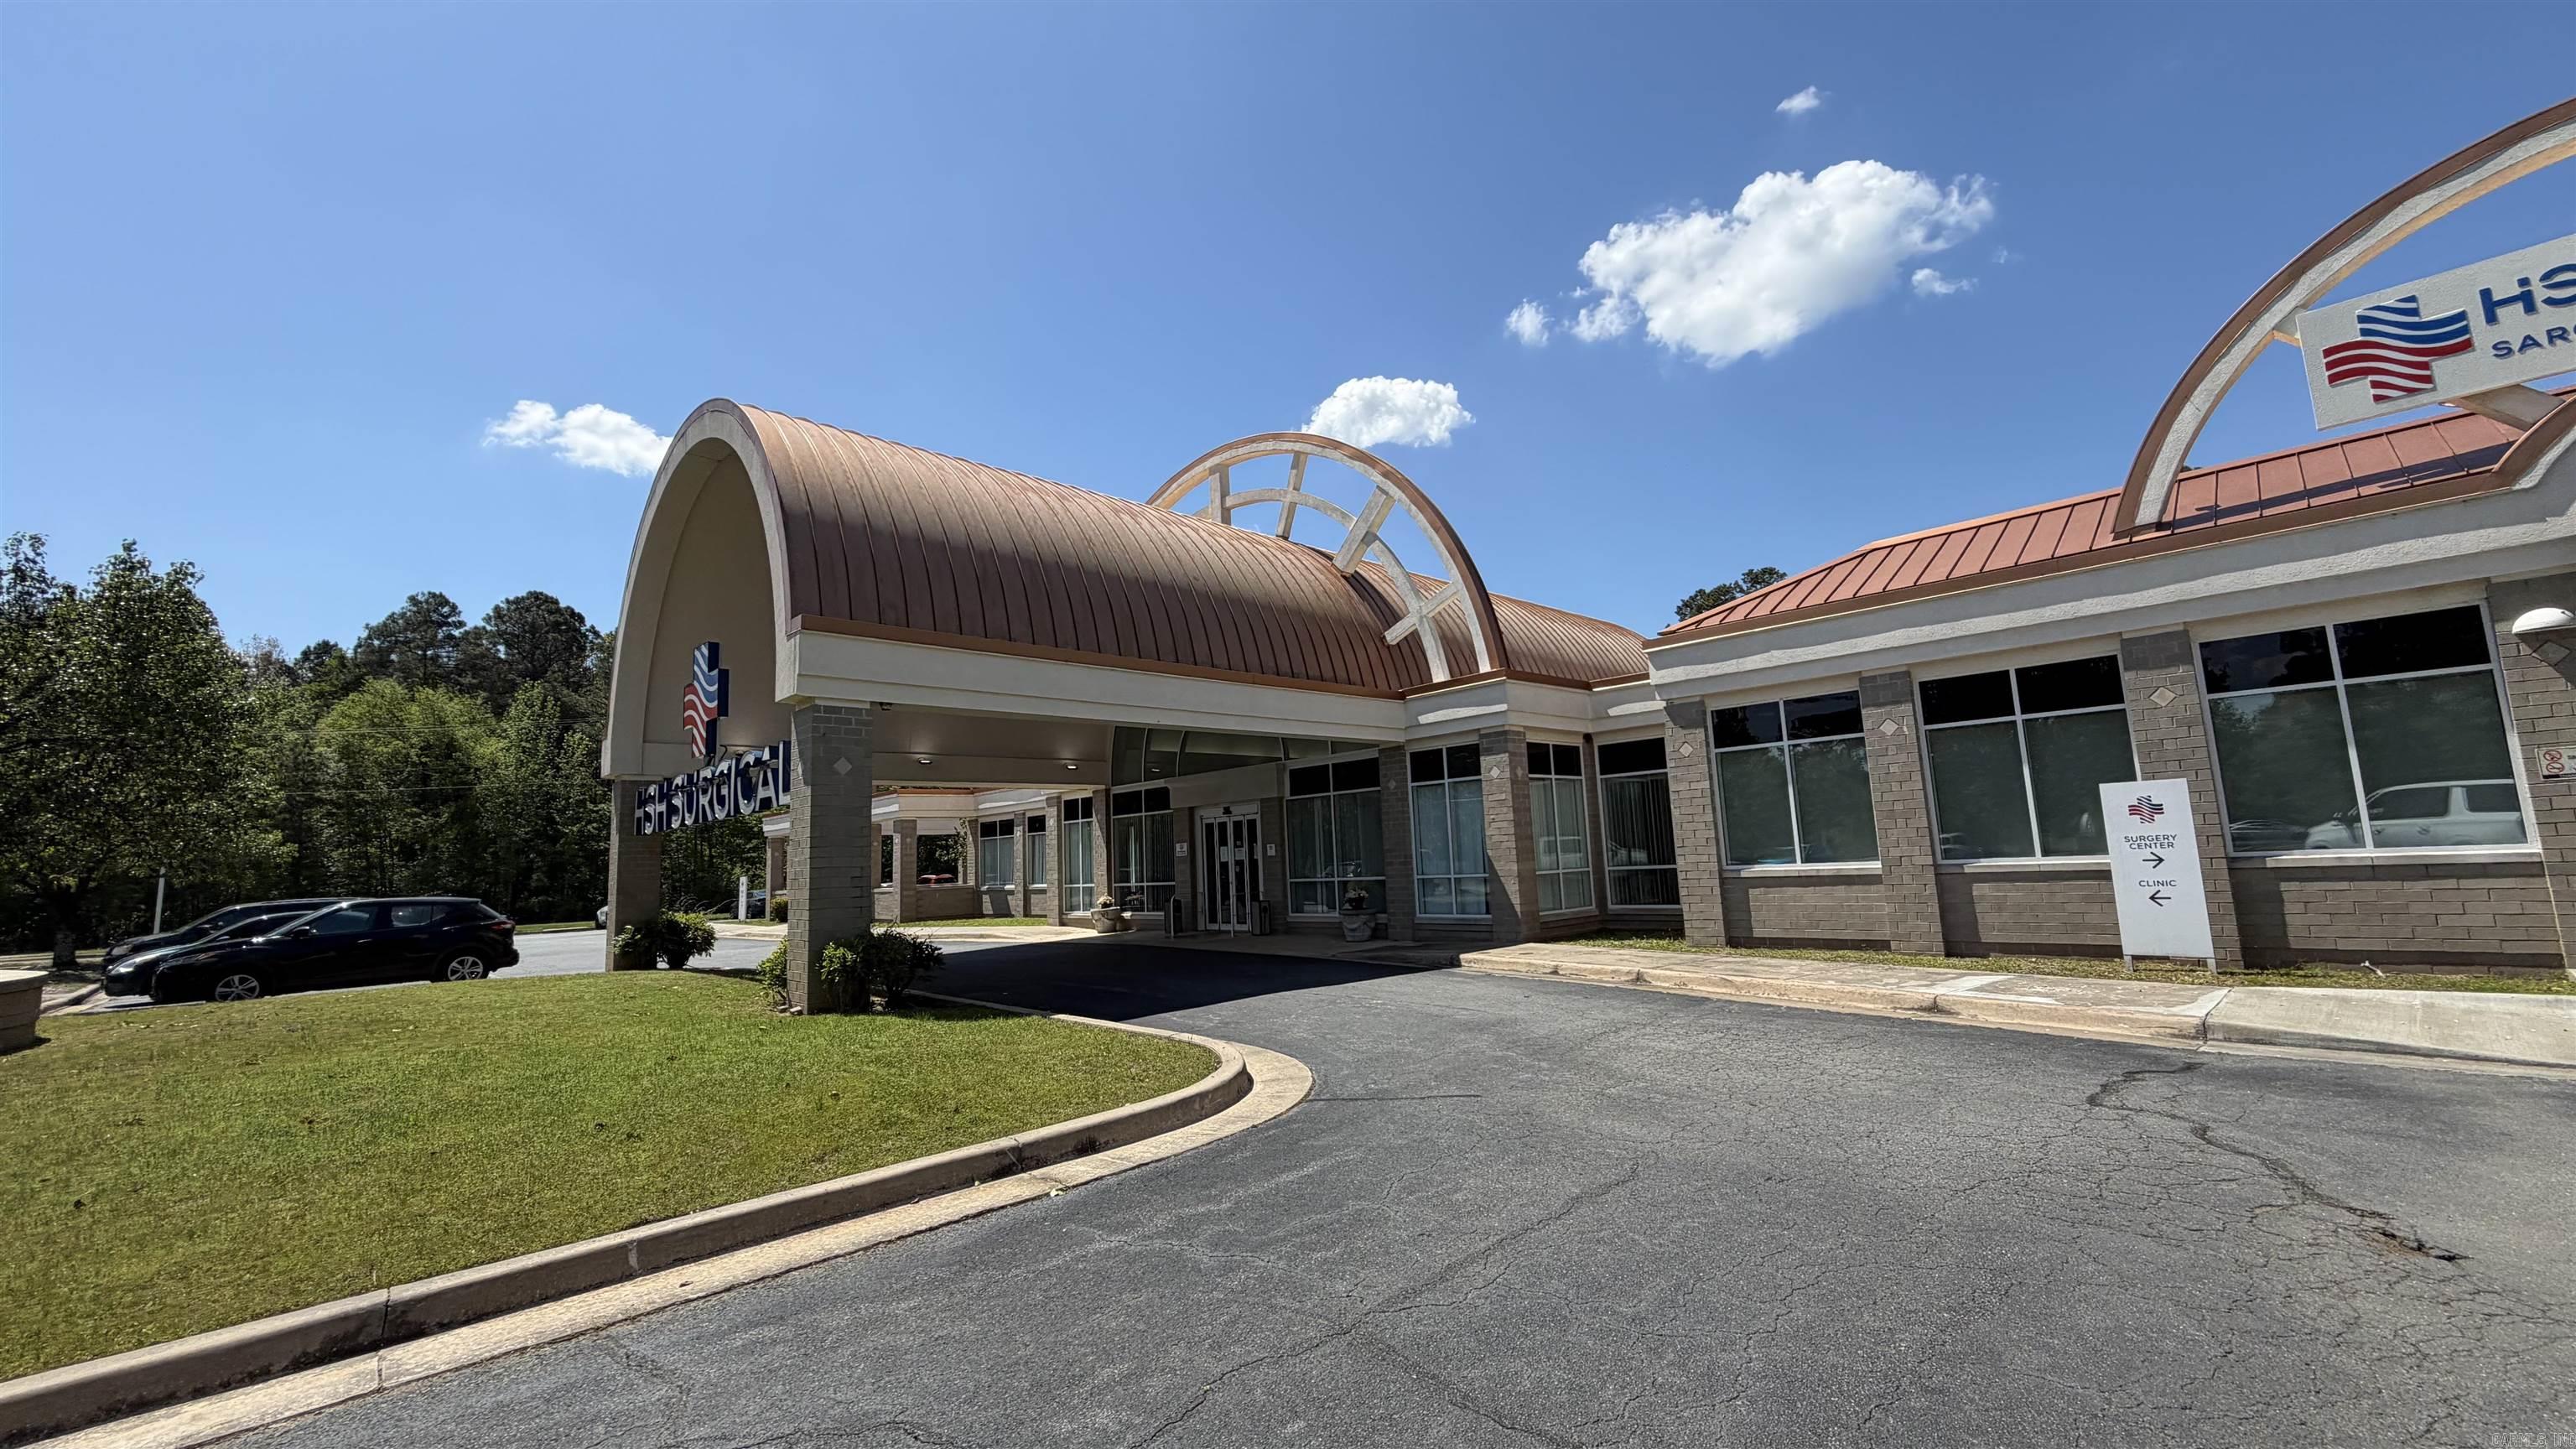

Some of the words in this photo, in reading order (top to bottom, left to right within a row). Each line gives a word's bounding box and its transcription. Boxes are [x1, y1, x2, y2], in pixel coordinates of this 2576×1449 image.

[2491, 324, 2576, 359] SAR
[634, 779, 668, 836] HSH
[671, 740, 792, 830] SURGICAL
[2123, 834, 2178, 843] SURGERY
[2129, 841, 2175, 850] CENTER
